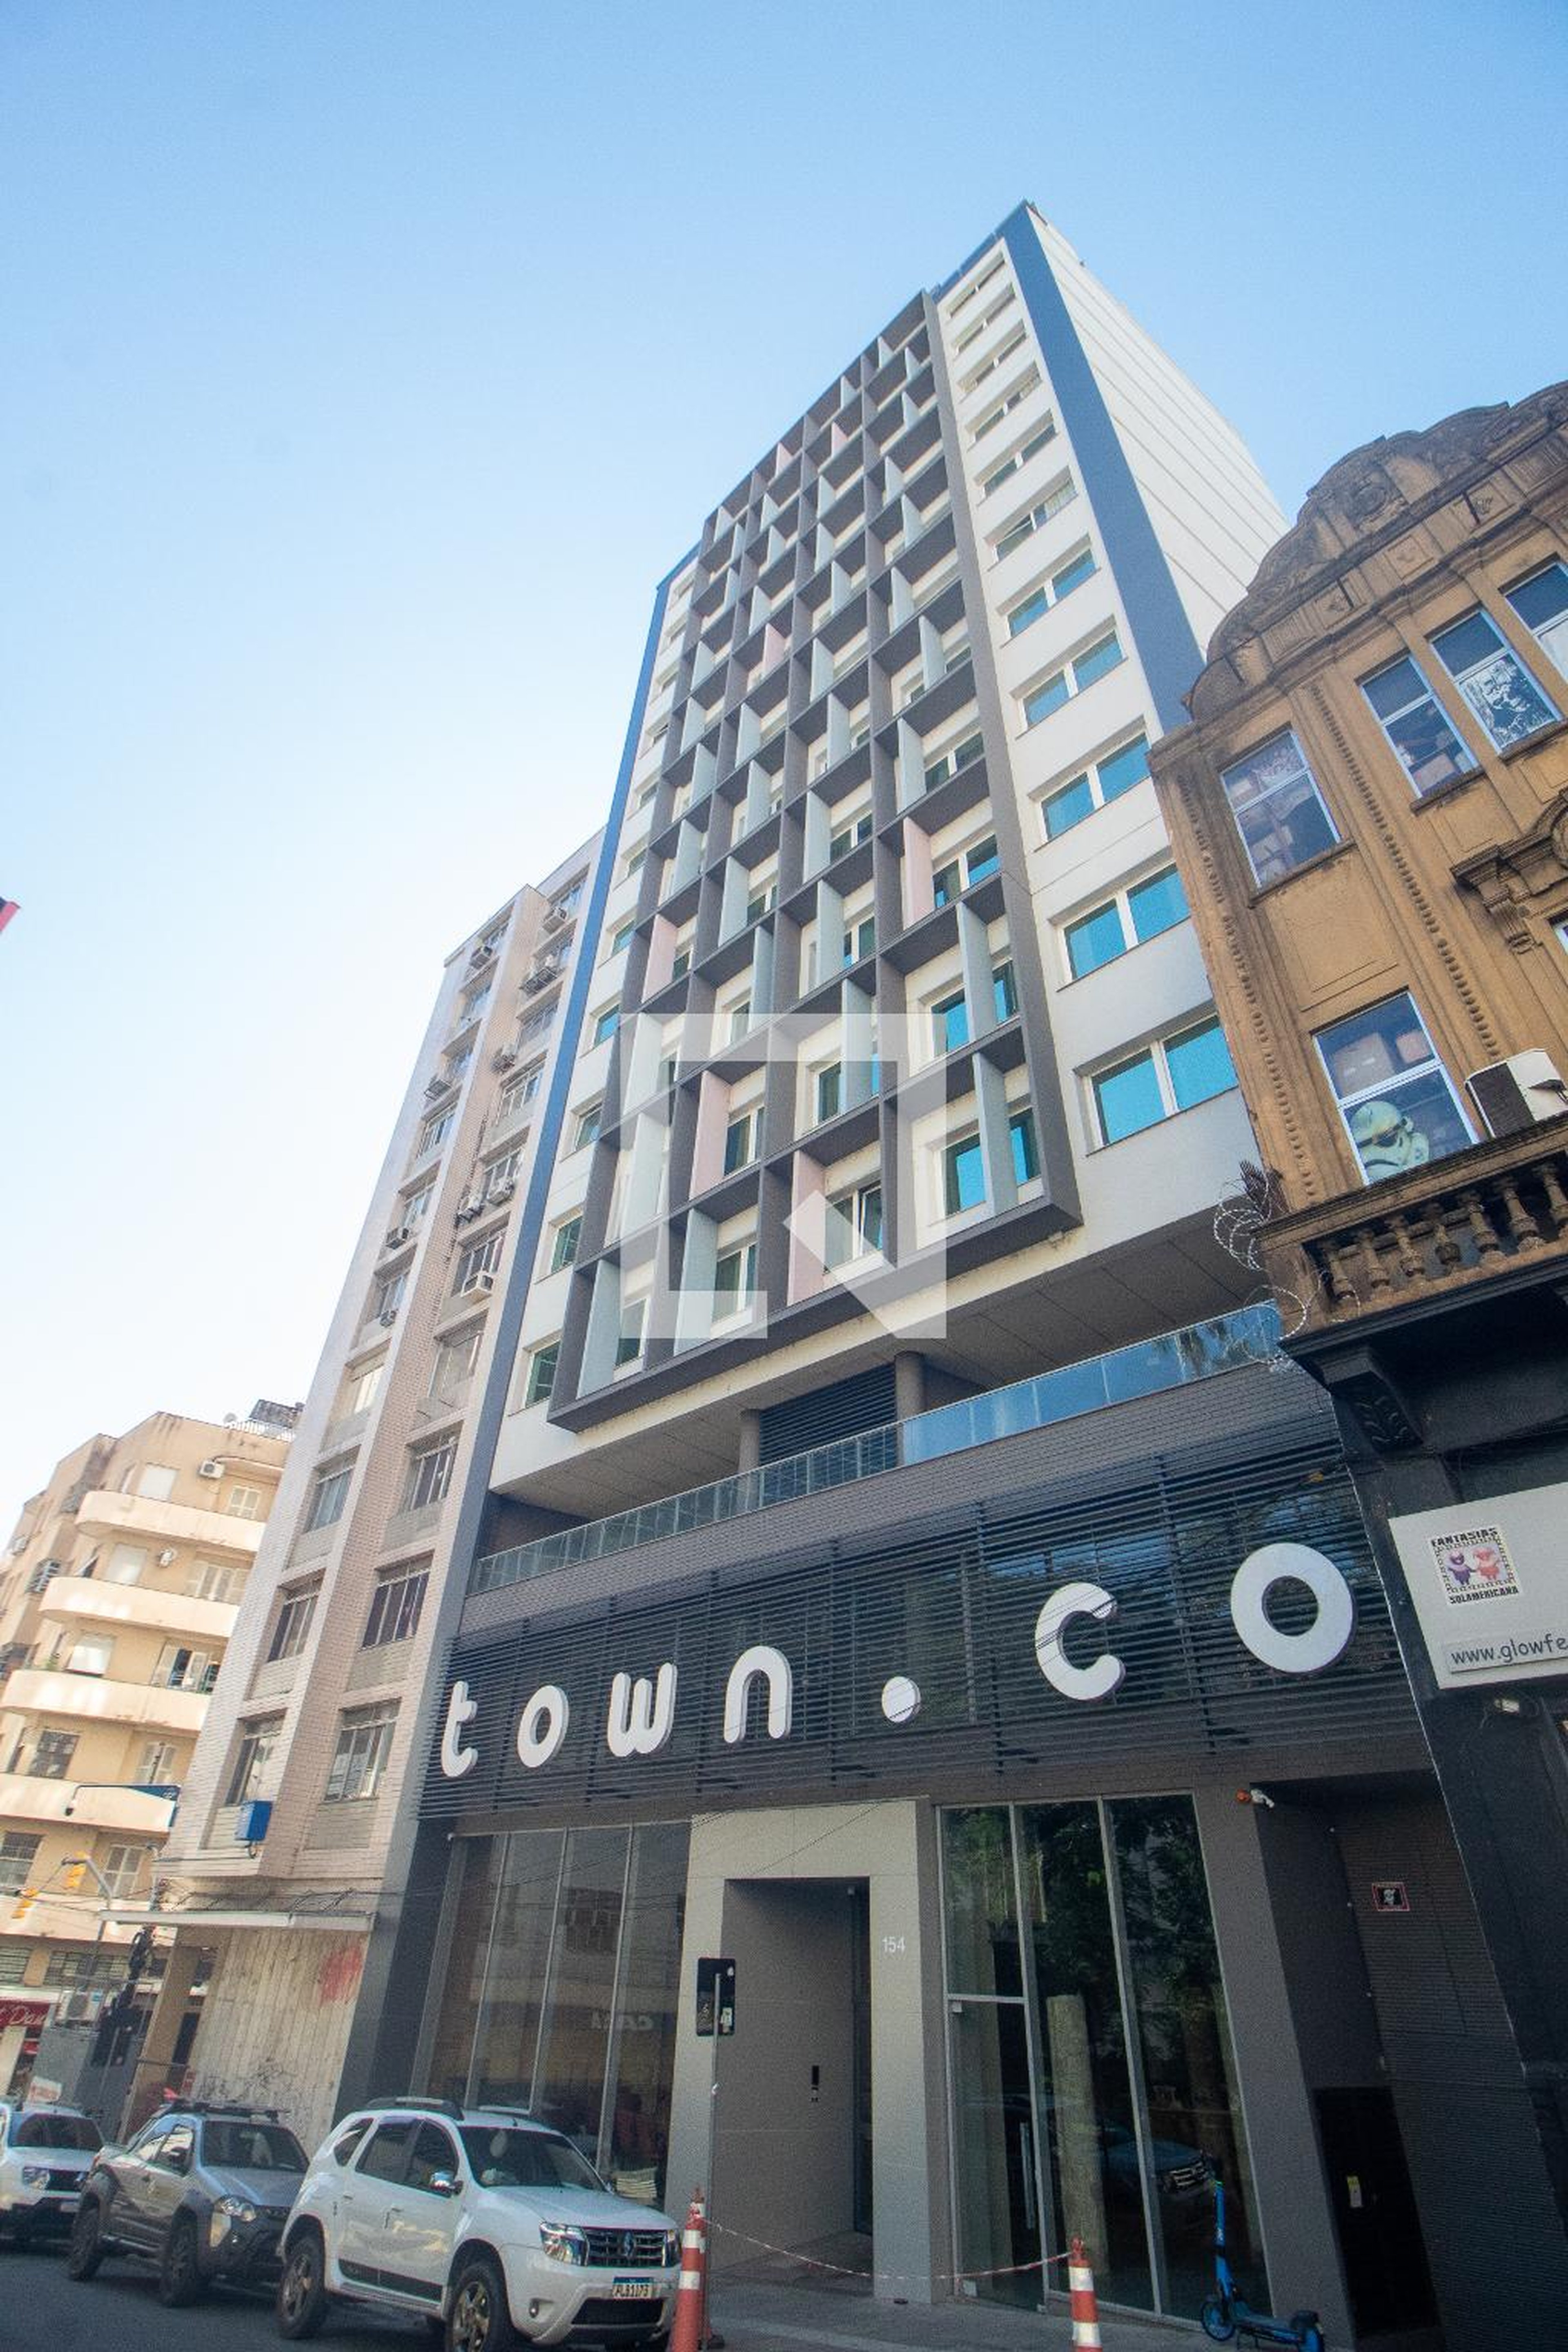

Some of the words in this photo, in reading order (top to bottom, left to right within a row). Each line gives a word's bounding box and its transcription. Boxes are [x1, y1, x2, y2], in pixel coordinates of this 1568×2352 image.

[1431, 1527, 1498, 1546] FANTASIAS
[441, 1542, 1356, 1777] town.co
[882, 1935, 906, 1952] 154
